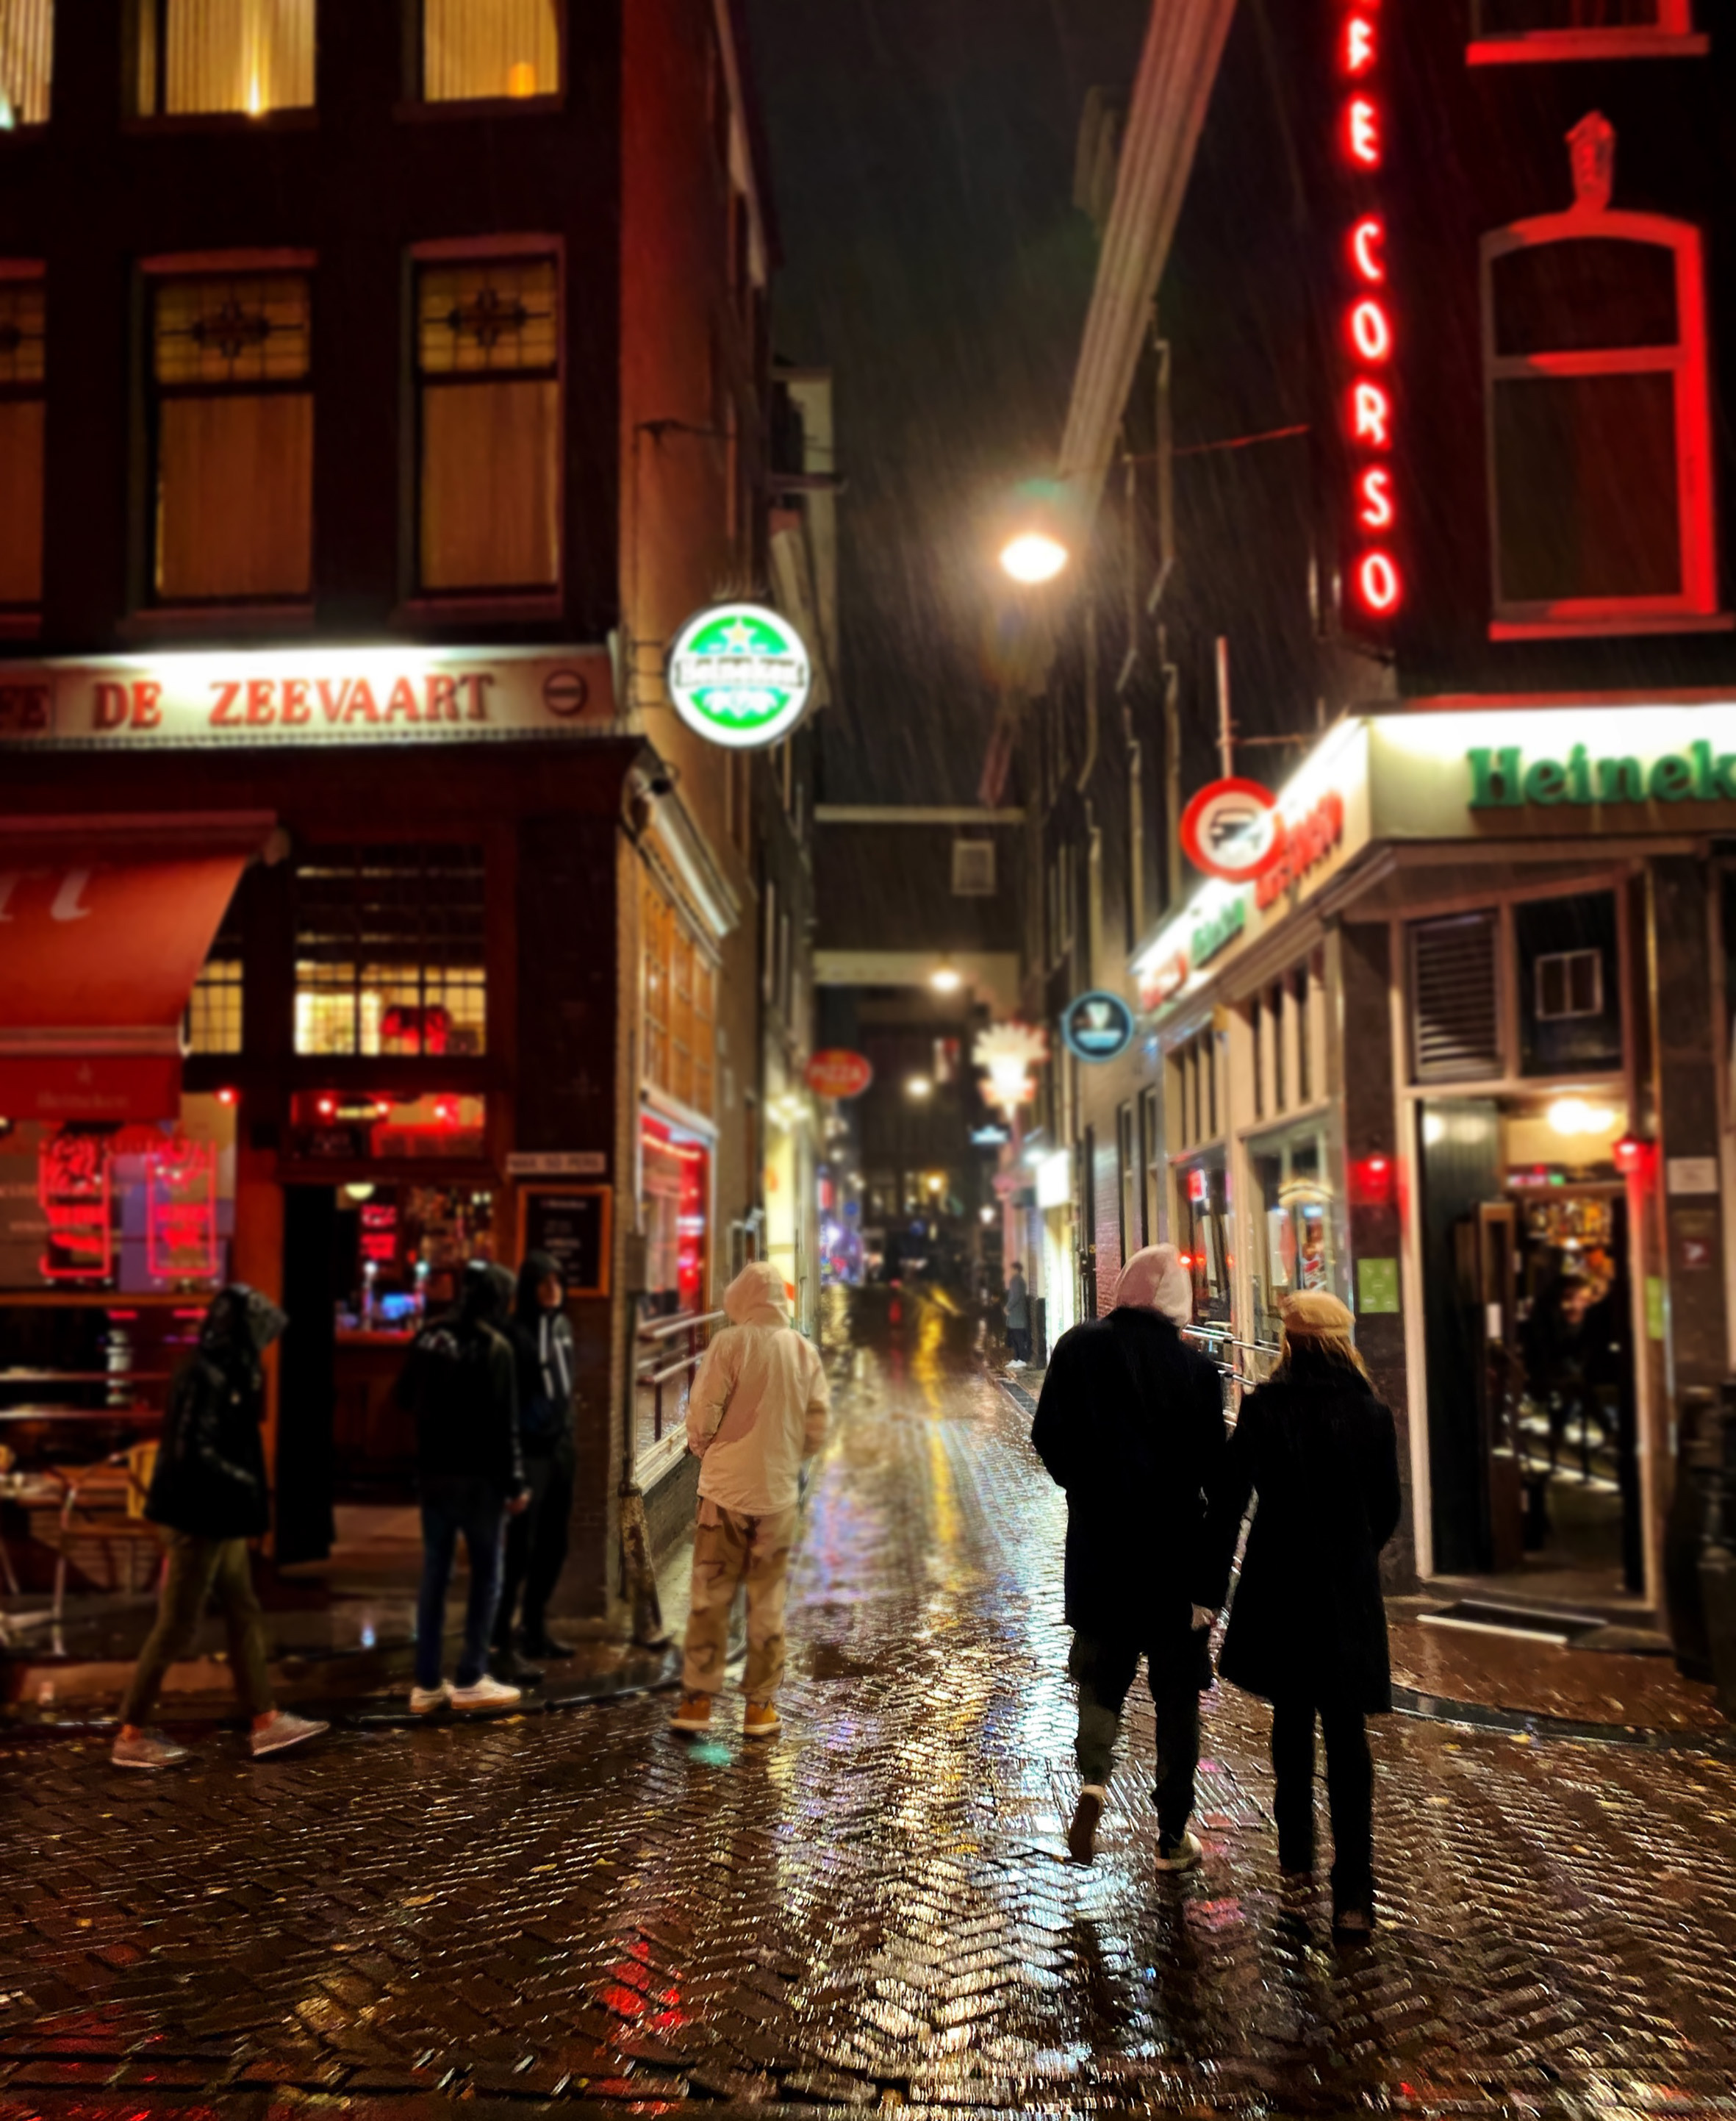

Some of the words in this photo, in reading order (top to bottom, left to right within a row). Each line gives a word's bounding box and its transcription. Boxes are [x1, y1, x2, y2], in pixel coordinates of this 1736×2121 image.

[1351, 221, 1401, 612] CORSO
[93, 682, 162, 729] DE
[209, 673, 495, 727] ZEEVAART
